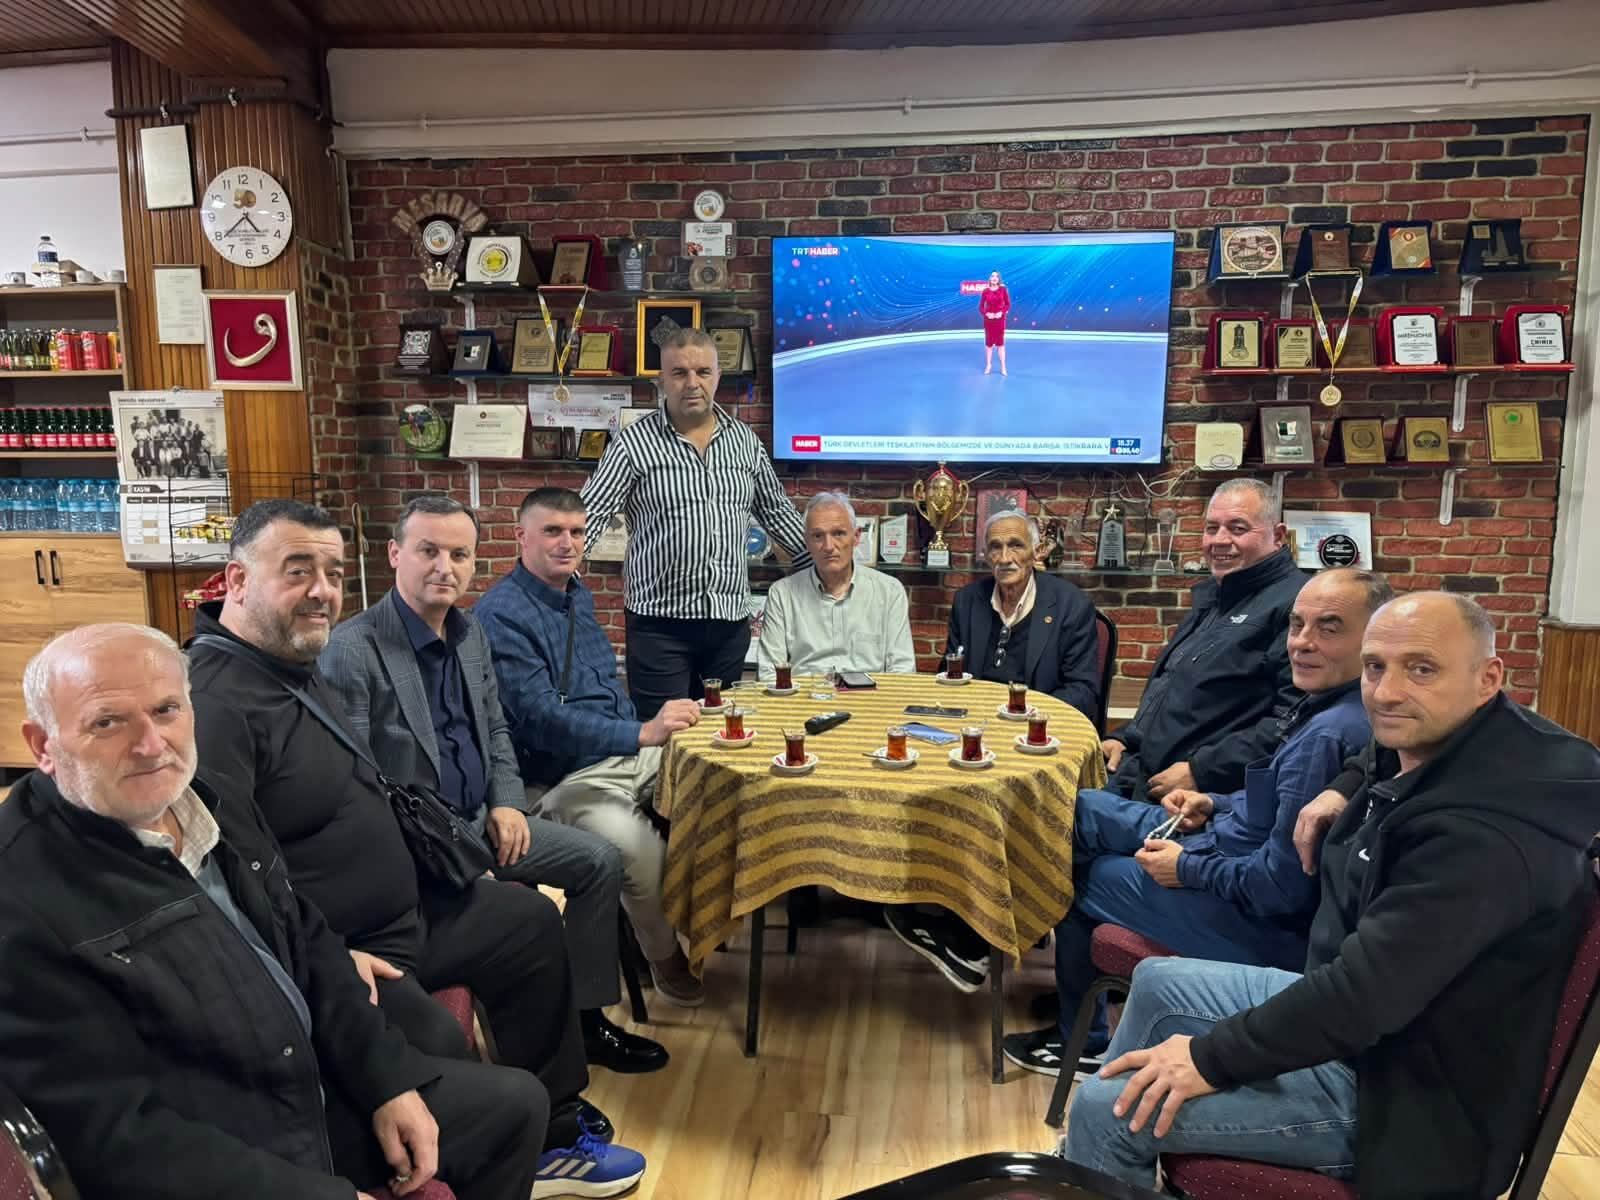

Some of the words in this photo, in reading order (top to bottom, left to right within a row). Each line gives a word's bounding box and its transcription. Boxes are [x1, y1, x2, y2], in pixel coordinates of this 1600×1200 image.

[222, 179, 231, 190] 11
[237, 174, 249, 185] 12
[258, 179, 263, 190] 1
[271, 192, 280, 203] 2
[207, 212, 216, 223] 9
[277, 211, 285, 222] 3
[214, 231, 223, 241] 8
[273, 229, 282, 239] 4
[227, 244, 235, 255] 7
[245, 249, 254, 259] 6
[261, 245, 270, 255] 5
[792, 248, 809, 256] TRT
[809, 247, 839, 256] HABER
